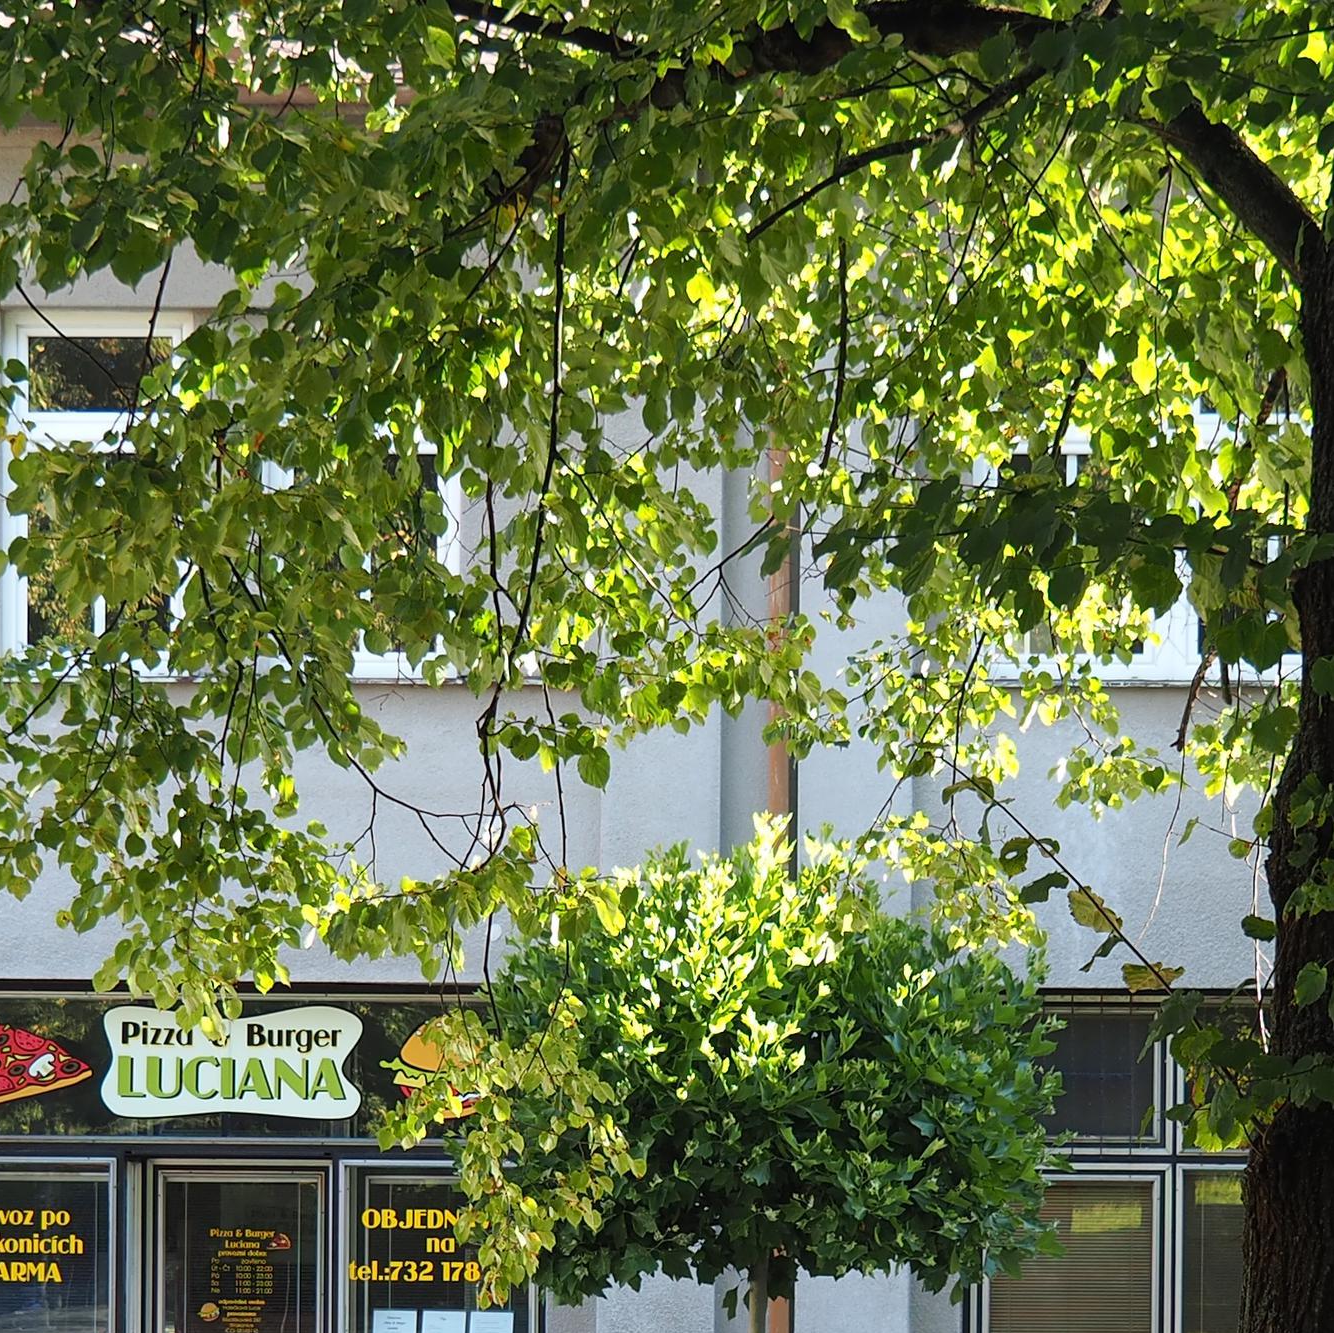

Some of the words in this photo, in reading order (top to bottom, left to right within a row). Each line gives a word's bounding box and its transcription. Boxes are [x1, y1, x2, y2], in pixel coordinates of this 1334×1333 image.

[121, 1021, 193, 1047] Pizza
[246, 1023, 342, 1053] Burger
[117, 1055, 347, 1101] LUCIANA
[40, 1209, 71, 1230] po
[361, 1207, 490, 1230] OBJEDN
[210, 1228, 234, 1238] Pizza
[235, 1229, 243, 1238] &
[245, 1229, 275, 1240] Burger
[225, 1240, 260, 1249] Luciana
[426, 1237, 455, 1253] na
[441, 1261, 481, 1282] 178
